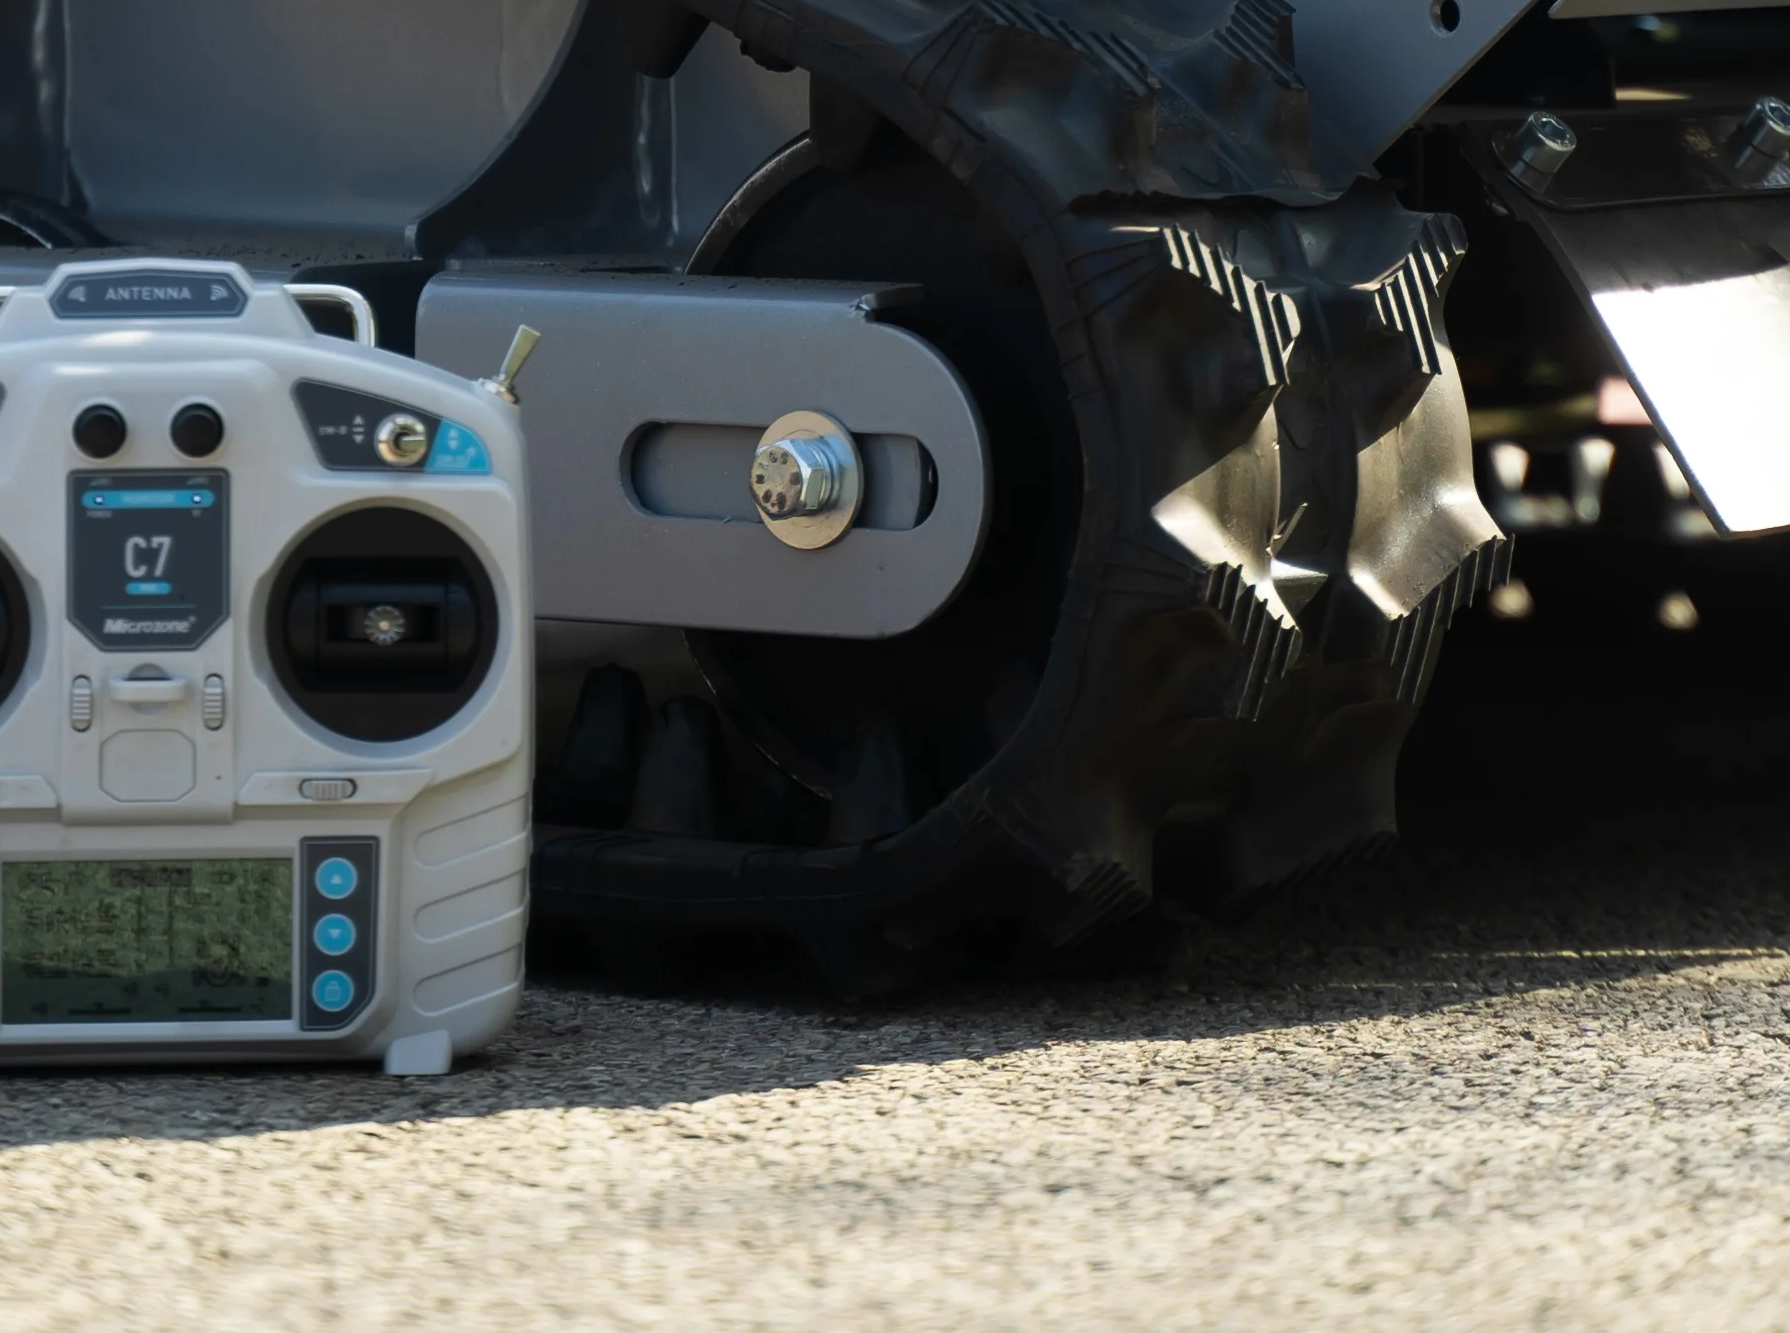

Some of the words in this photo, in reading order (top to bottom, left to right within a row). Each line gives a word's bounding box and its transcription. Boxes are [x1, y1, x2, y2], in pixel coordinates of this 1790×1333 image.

[104, 286, 192, 301] ANTENNA
[124, 535, 173, 578] C7
[103, 617, 190, 634] Microzone
